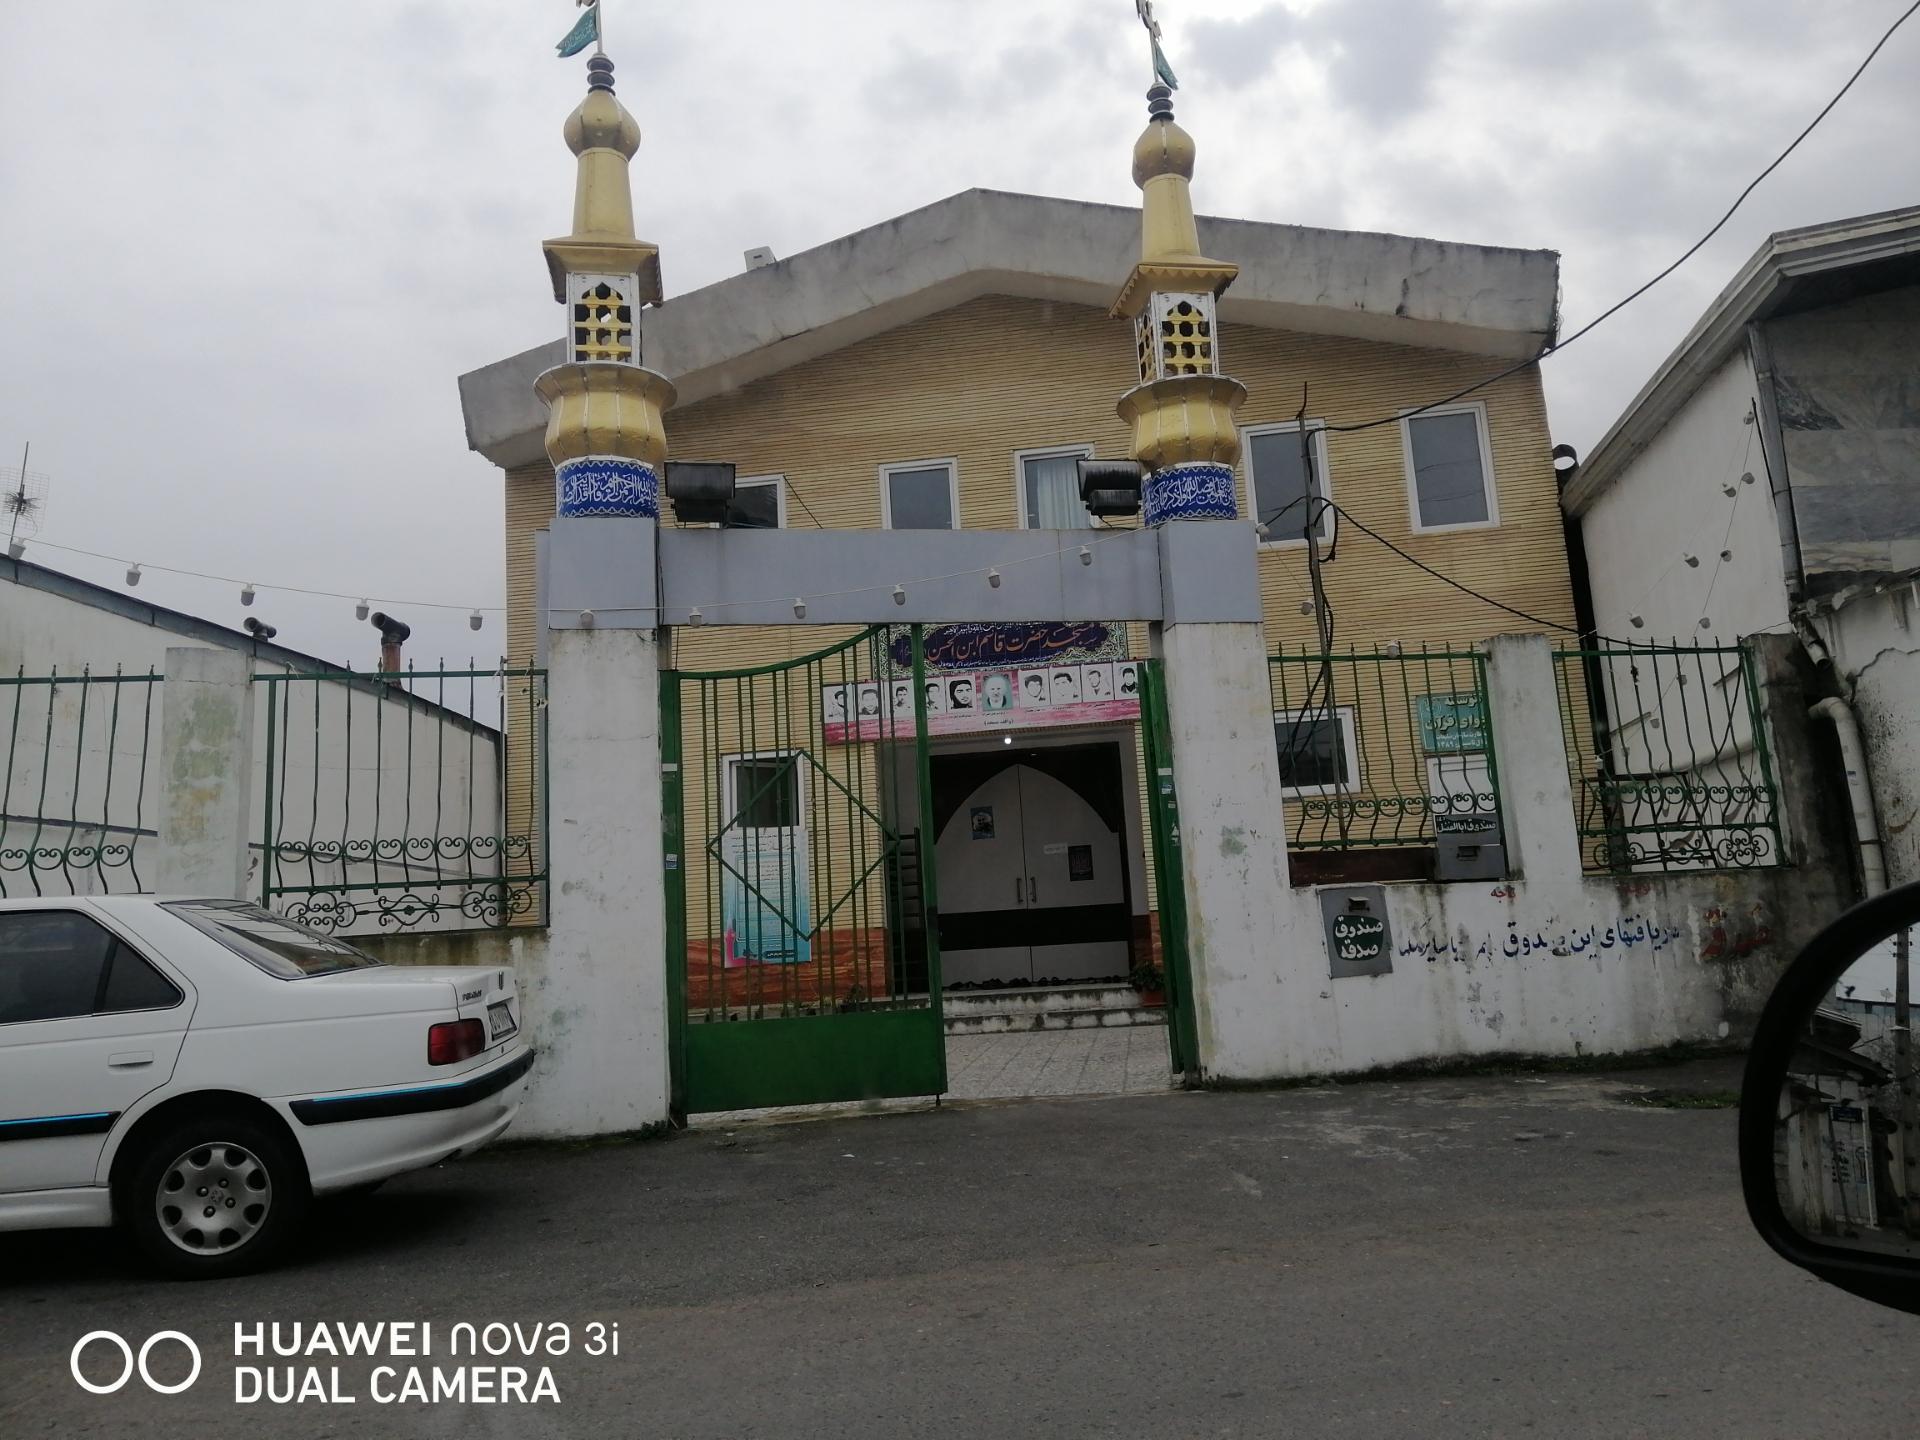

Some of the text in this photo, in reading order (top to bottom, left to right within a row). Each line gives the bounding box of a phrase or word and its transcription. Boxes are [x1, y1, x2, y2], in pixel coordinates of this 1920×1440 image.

[956, 635, 979, 660] ابن
[978, 628, 1005, 658] قاسم
[1006, 628, 1048, 651] حضرت
[1335, 916, 1384, 938] صندوق
[1341, 939, 1378, 959] صدقه
[1571, 925, 1597, 959] این
